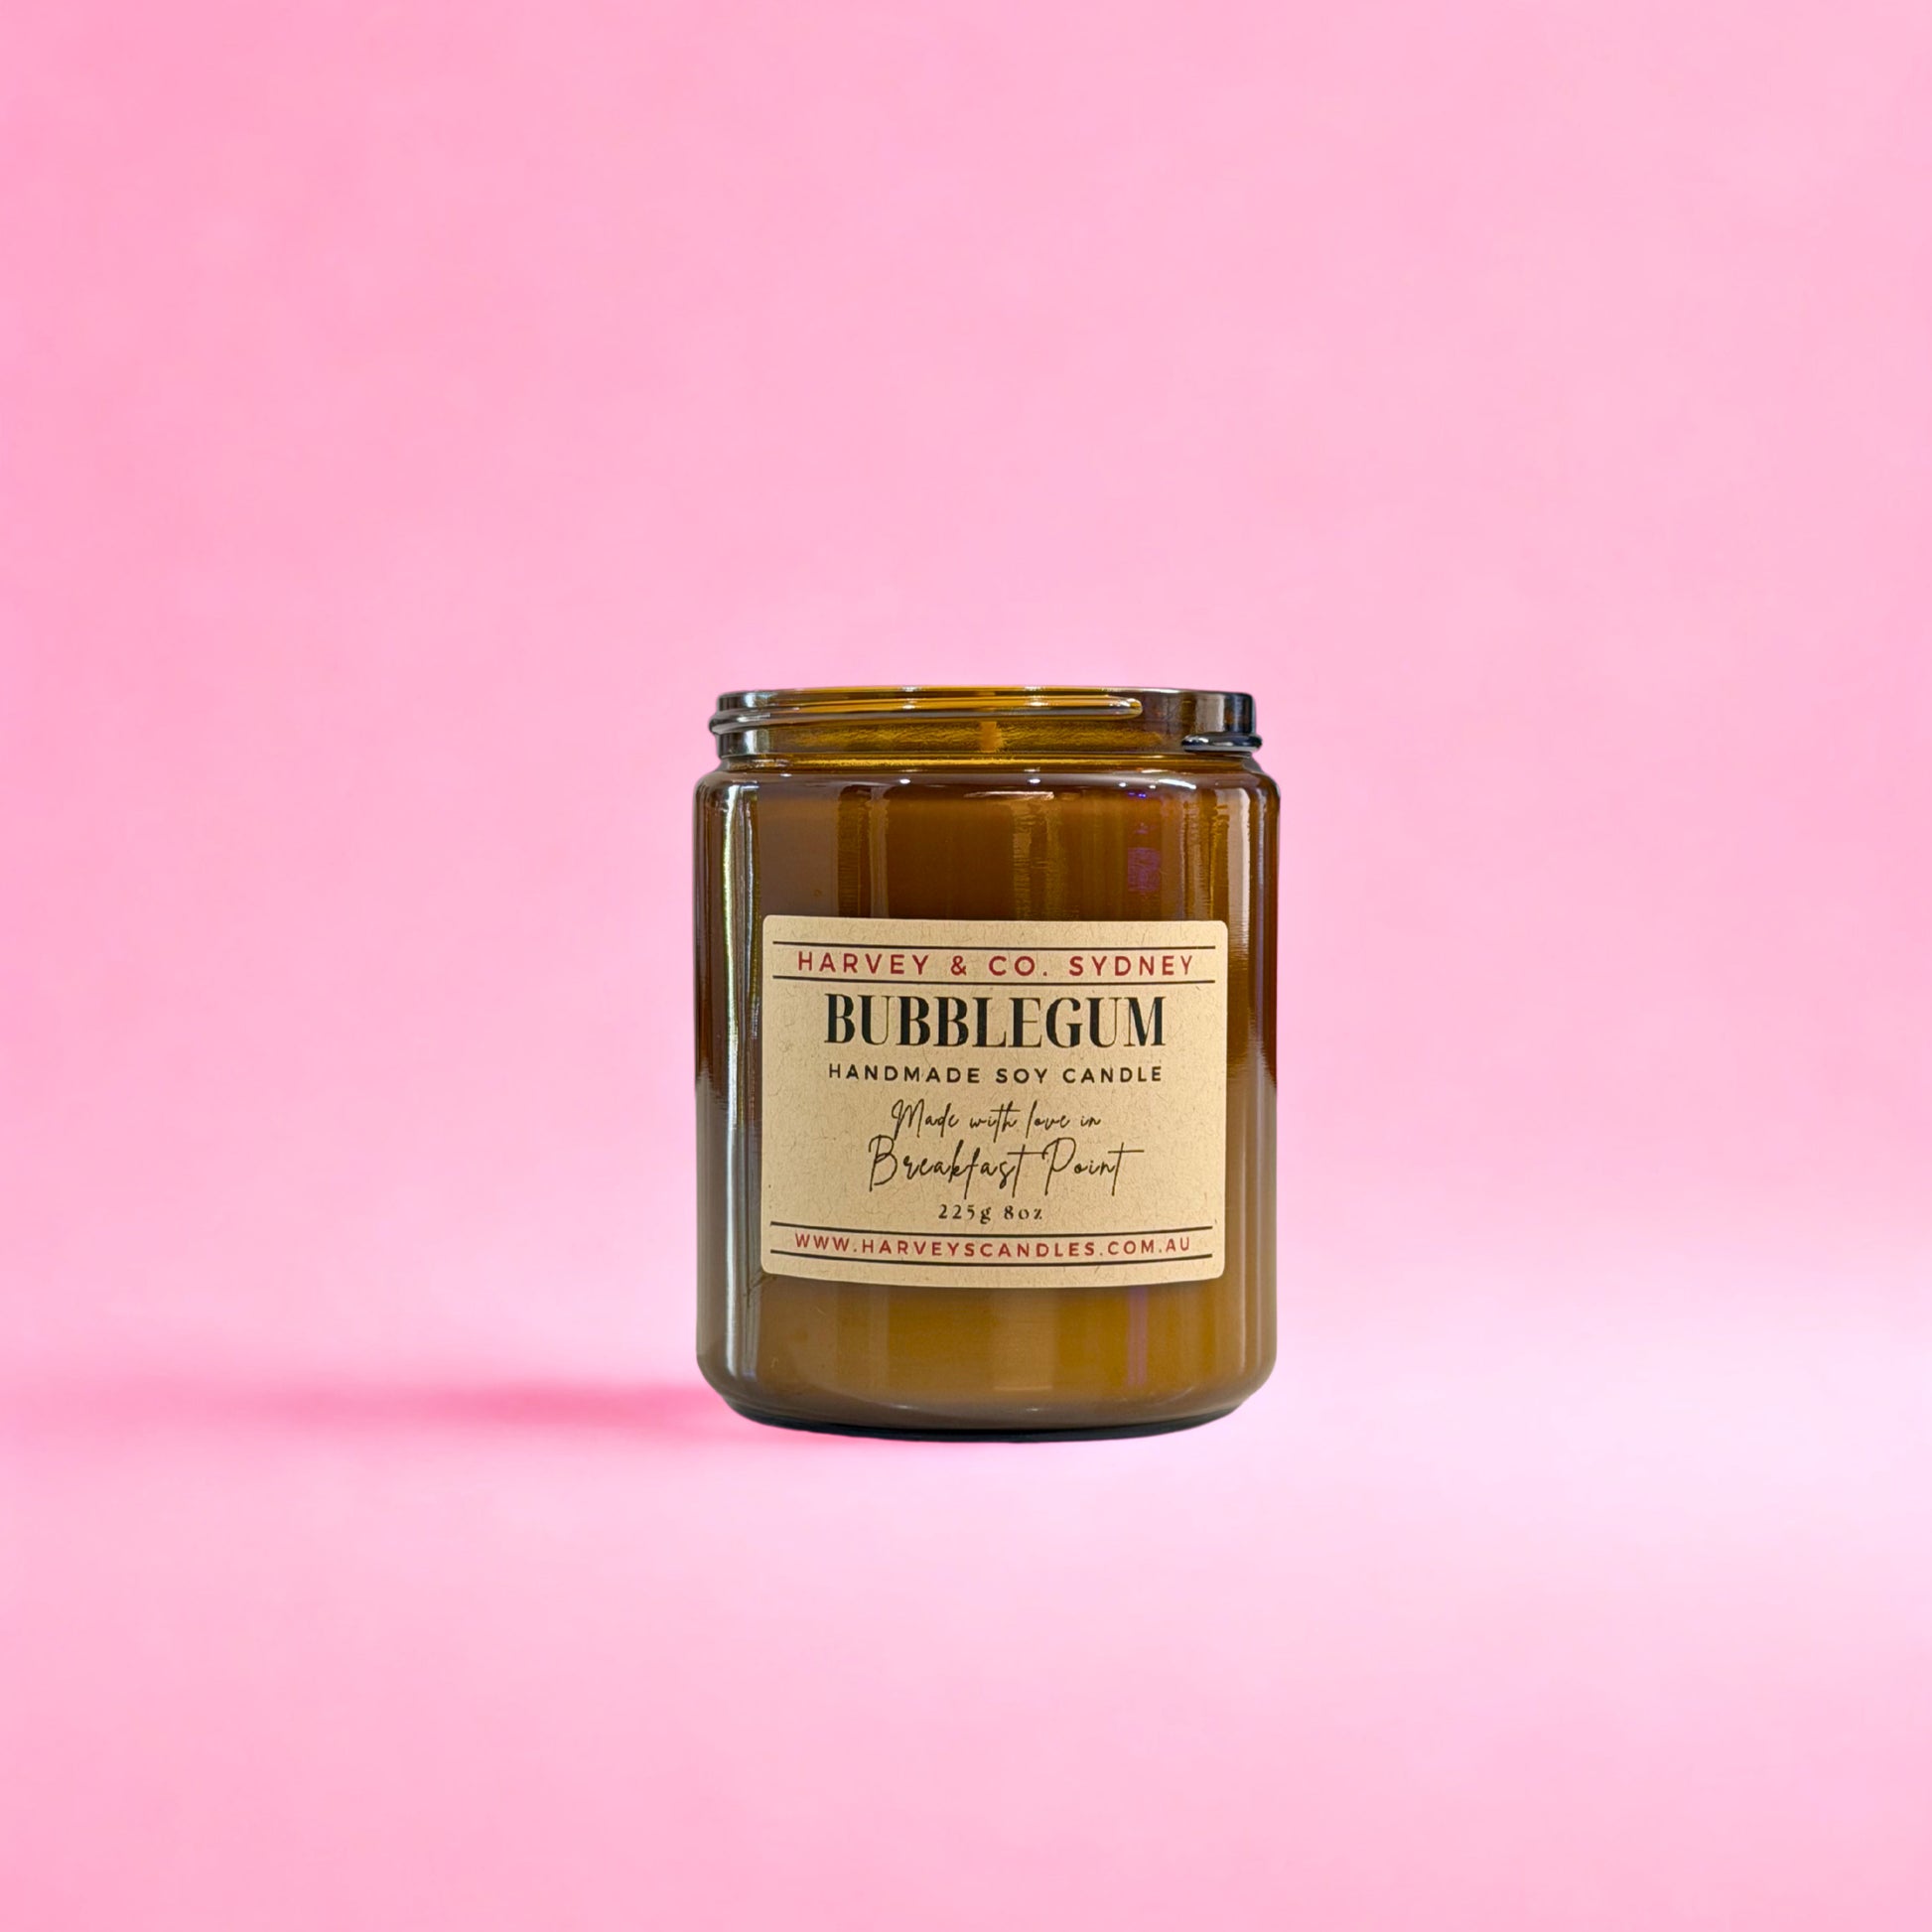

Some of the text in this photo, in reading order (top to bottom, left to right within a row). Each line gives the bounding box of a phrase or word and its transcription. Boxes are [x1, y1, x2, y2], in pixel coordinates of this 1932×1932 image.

[797, 950, 1194, 978] HARVEY & CO. SYDNEY
[823, 993, 1167, 1048] BUBBLEGUM
[828, 1062, 1163, 1084] HANDMADE SOY CANDLE
[891, 1098, 1103, 1144] Made with love in
[868, 1134, 1146, 1200] Breakfast Point
[937, 1203, 1044, 1224] 225g 8oz
[794, 1231, 1192, 1258] WWW.HARVEYSCANDLES.COM.AU
